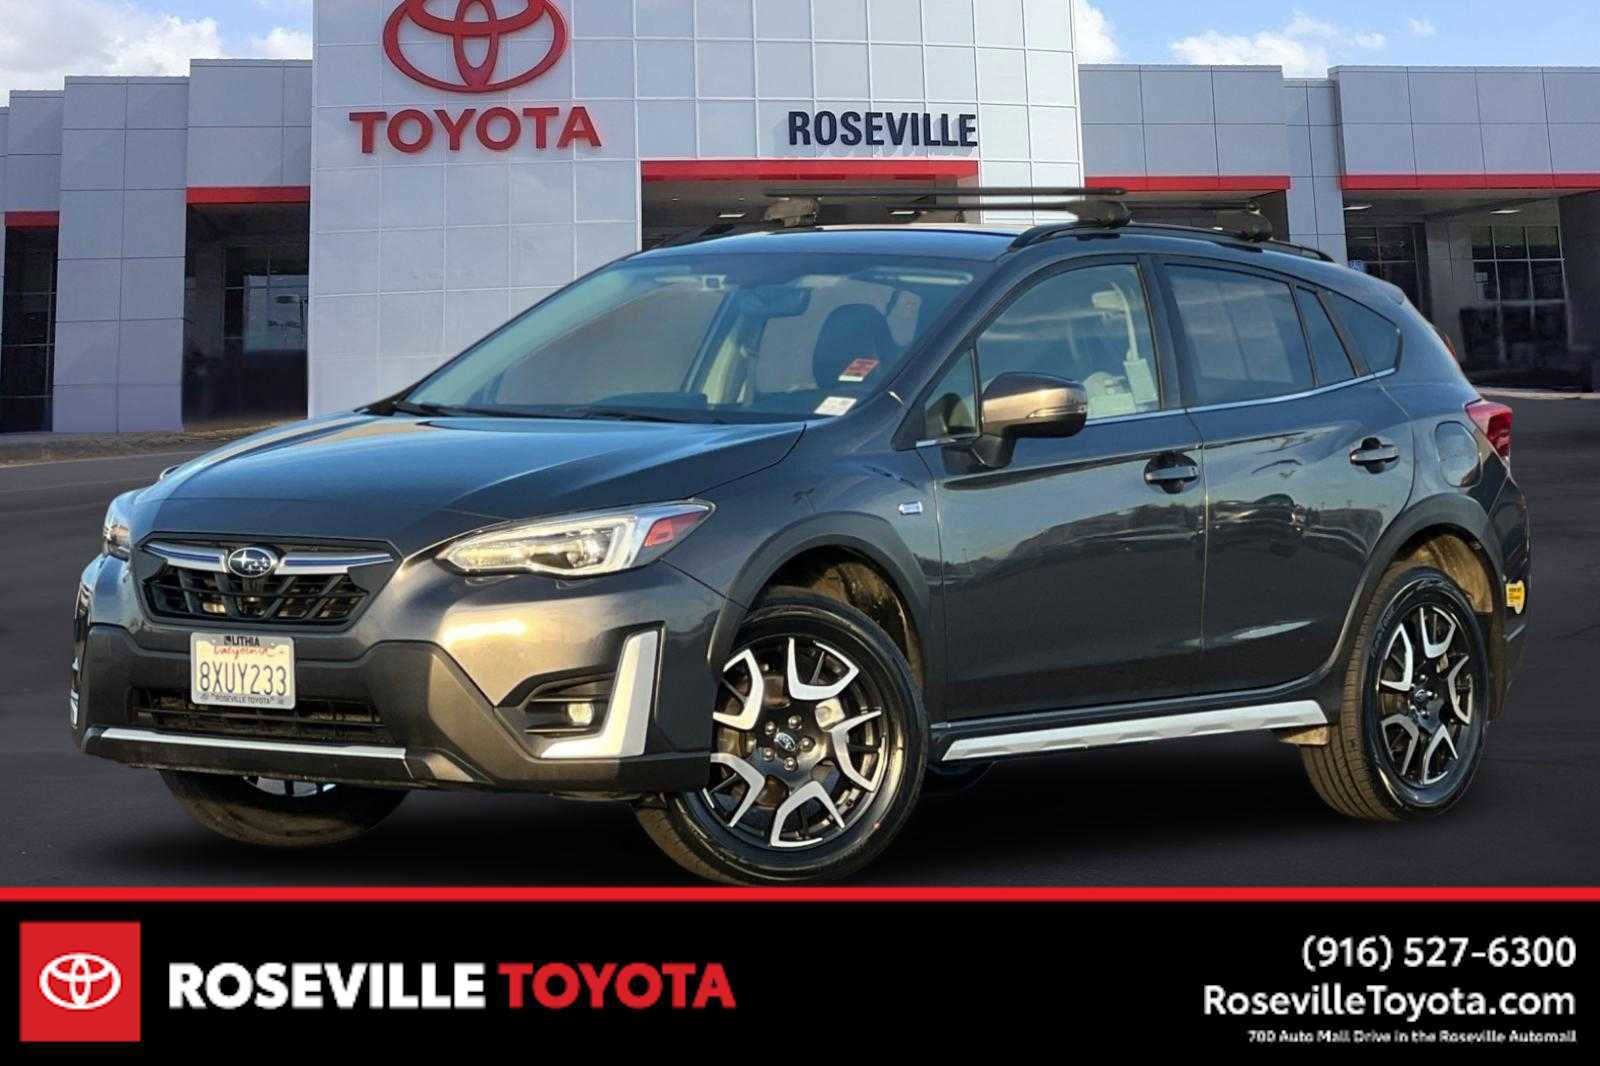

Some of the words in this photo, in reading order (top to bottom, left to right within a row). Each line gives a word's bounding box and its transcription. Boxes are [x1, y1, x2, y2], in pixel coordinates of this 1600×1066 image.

[349, 106, 602, 154] TOYOTA
[788, 111, 978, 147] ROSEVILLE
[232, 635, 260, 647] LITHIA
[199, 661, 287, 697] 8XUY233
